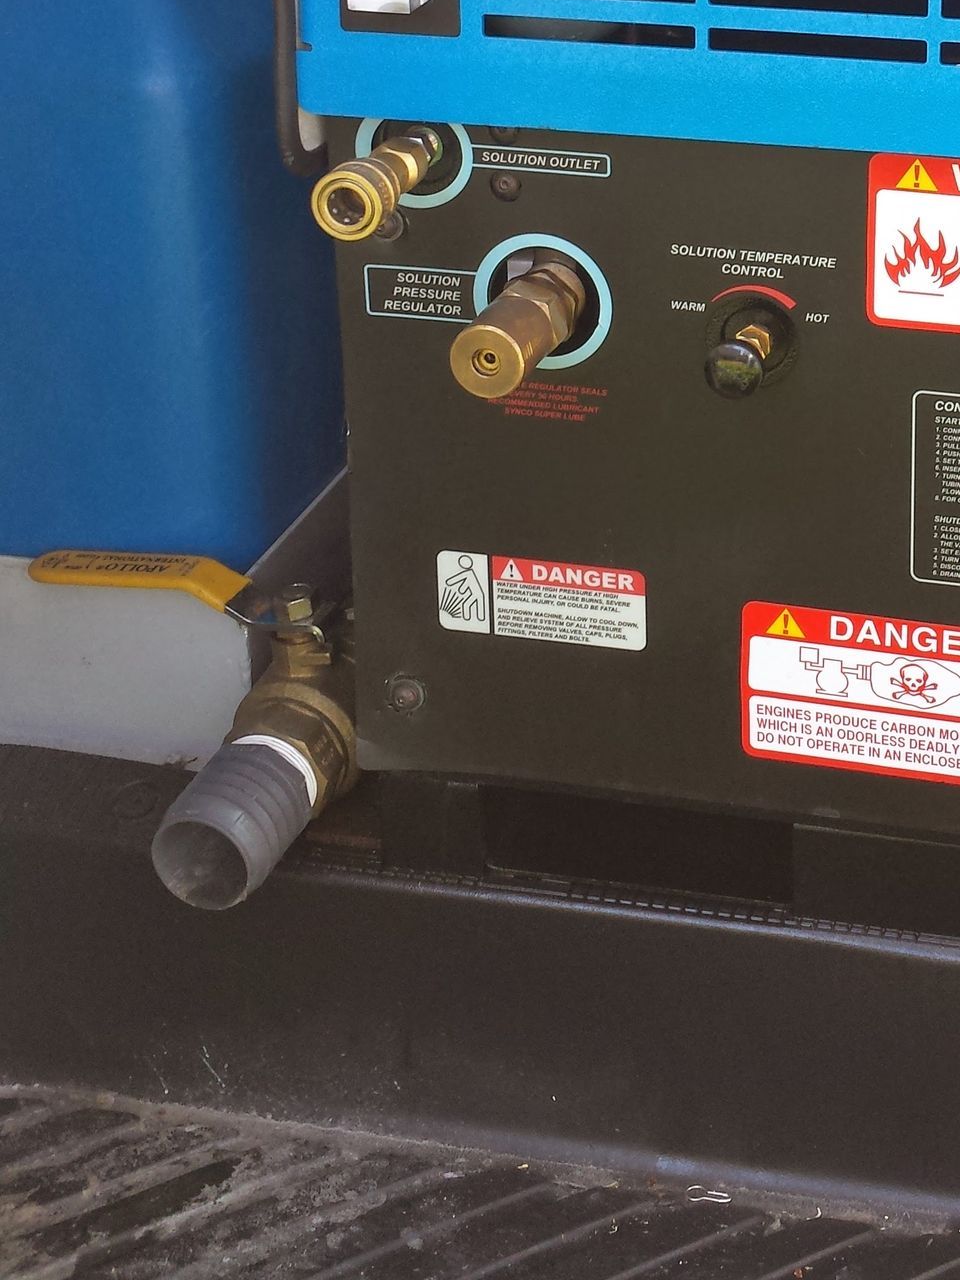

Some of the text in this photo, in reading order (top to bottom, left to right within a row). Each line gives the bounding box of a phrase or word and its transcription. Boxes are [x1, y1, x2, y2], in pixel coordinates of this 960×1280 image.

[481, 151, 600, 170] SOLUTION OUTLET
[670, 244, 836, 268] SOLUTION TEMPERATURE
[396, 272, 460, 286] SOLUTION
[721, 263, 783, 278] CONTROL
[393, 286, 461, 301] PRESSURE
[383, 299, 461, 315] REGULATOR
[671, 300, 705, 312] WARM
[805, 312, 829, 323] HOT
[532, 564, 634, 590] DANGER
[756, 703, 811, 721] ENGINES
[815, 711, 877, 730] PRODUCE
[880, 720, 935, 738] CARBON
[756, 717, 797, 733] WHICH
[800, 723, 812, 735] IS
[815, 725, 833, 738] AN
[836, 728, 905, 748] ODORLESS
[909, 738, 960, 755] DEADLY
[756, 731, 774, 743] DO
[777, 733, 803, 747] NOT
[806, 737, 864, 756] OPERATE
[868, 746, 880, 758] IN
[883, 748, 901, 761] AN
